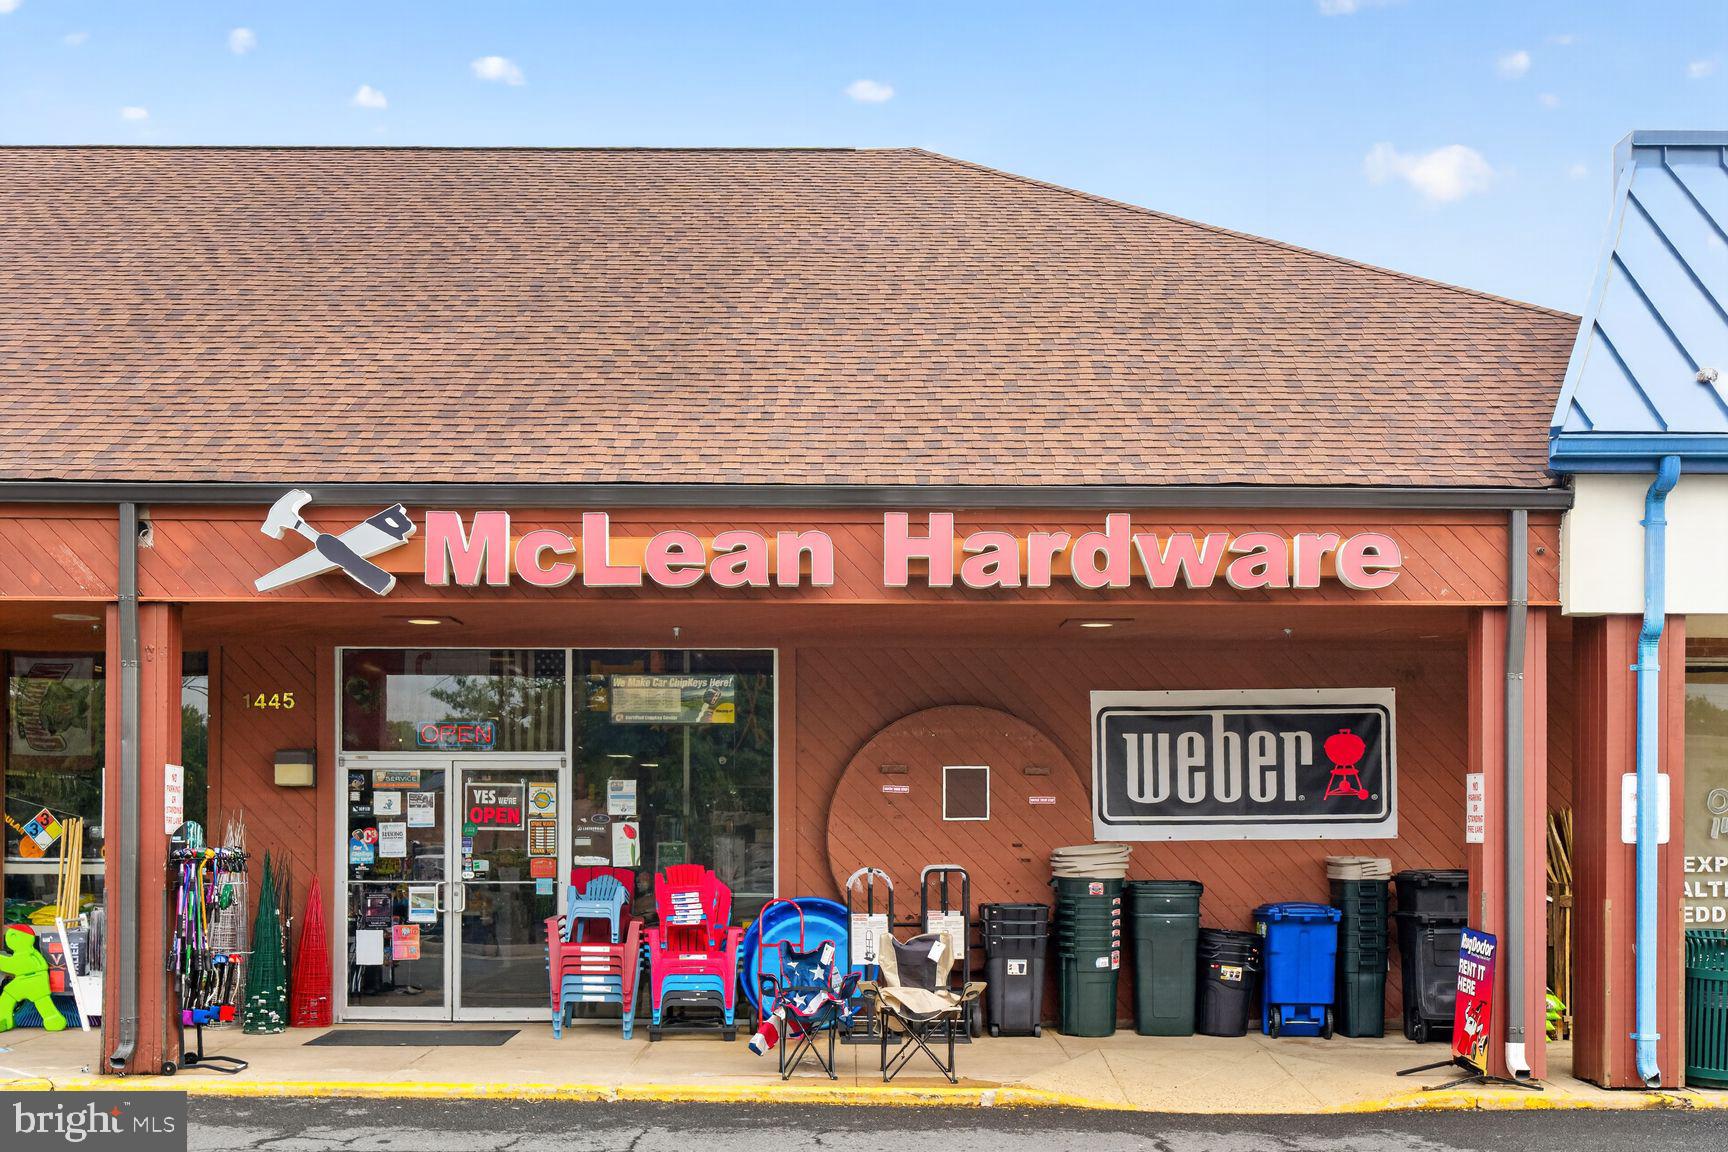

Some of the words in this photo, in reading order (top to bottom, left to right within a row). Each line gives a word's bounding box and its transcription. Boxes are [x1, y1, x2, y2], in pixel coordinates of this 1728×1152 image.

[425, 510, 835, 588] McLean
[883, 511, 1402, 590] Hardware
[613, 678, 625, 687] We
[626, 678, 650, 687] Make
[652, 678, 667, 687] Car
[709, 678, 733, 687] Here!
[242, 692, 296, 710] 1445
[421, 724, 492, 743] OPEN
[1122, 713, 1313, 804] weber
[171, 773, 177, 782] NO
[1472, 782, 1478, 791] NO
[473, 789, 495, 804] YES
[498, 797, 517, 805] WE'RE
[469, 807, 520, 824] OPEN
[1473, 804, 1478, 812] OR
[41, 813, 49, 826] 3
[30, 822, 38, 836] 3
[1458, 957, 1477, 979] RENT
[1477, 964, 1486, 981] IT
[1457, 975, 1476, 997] HERE
